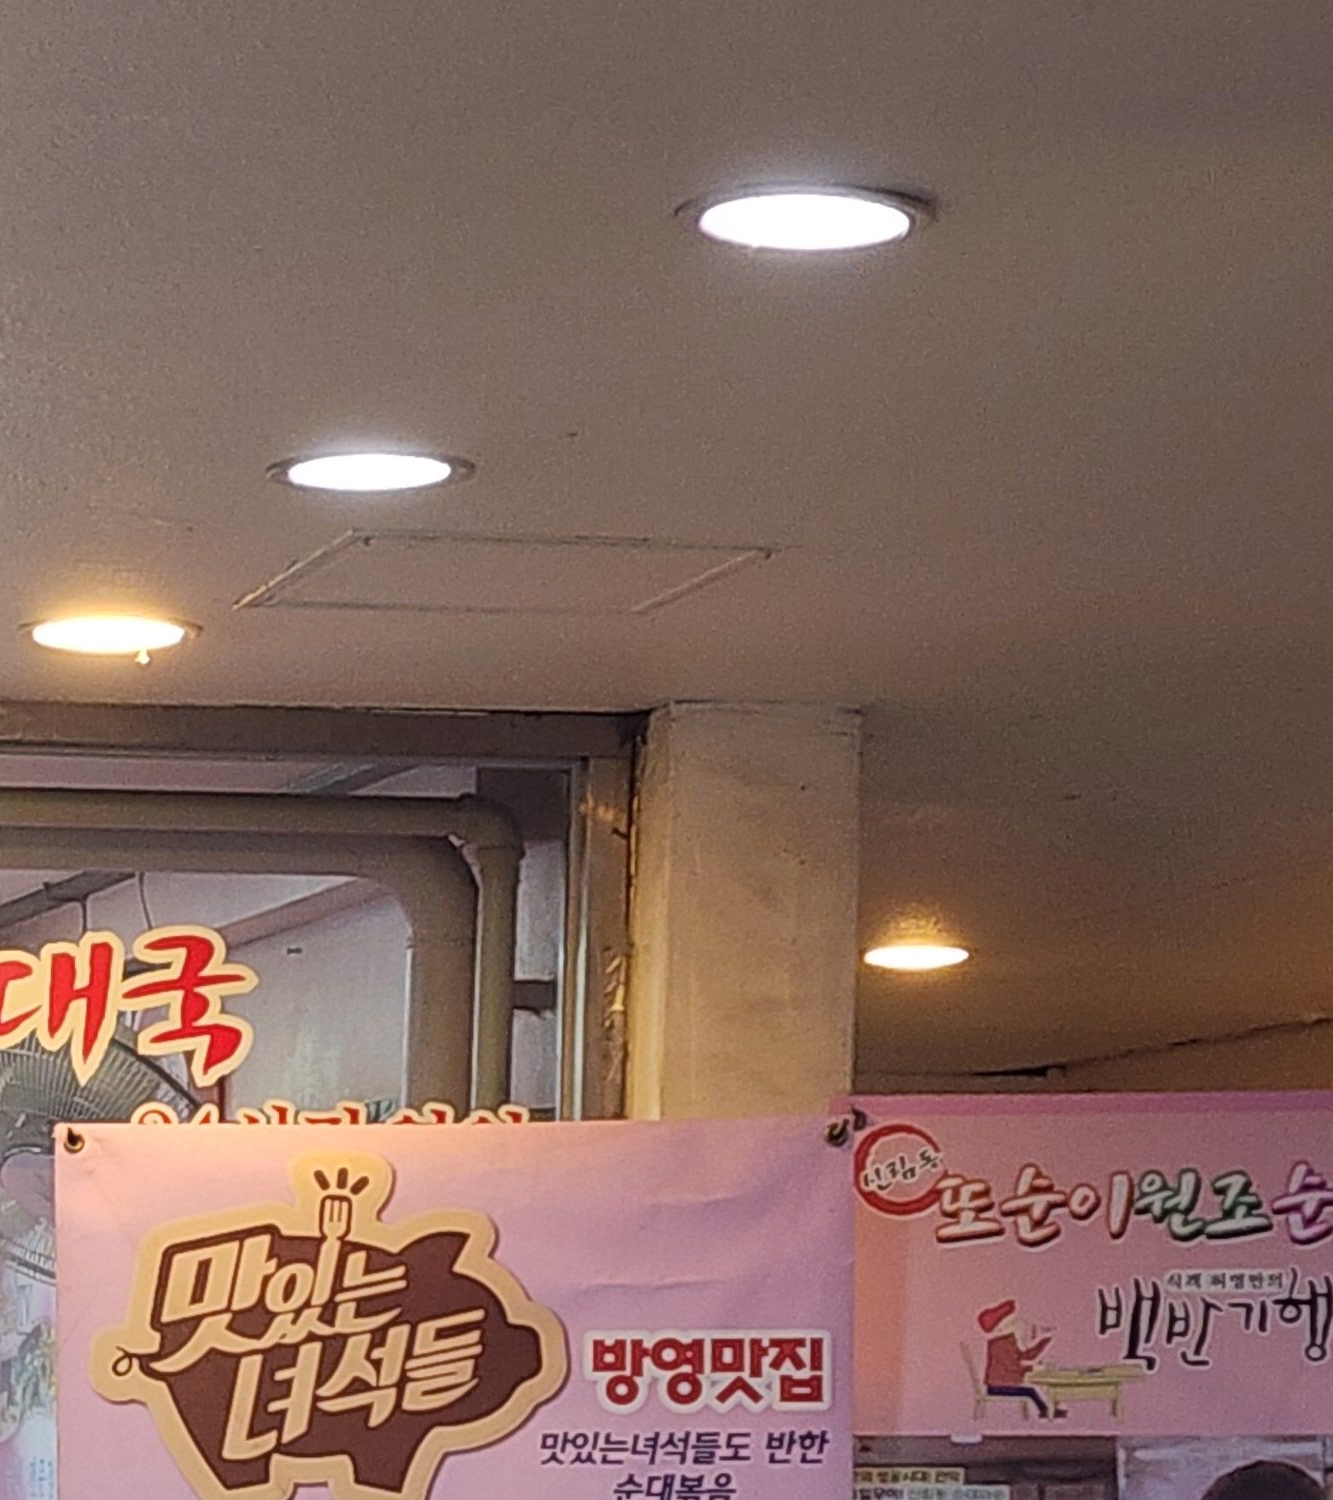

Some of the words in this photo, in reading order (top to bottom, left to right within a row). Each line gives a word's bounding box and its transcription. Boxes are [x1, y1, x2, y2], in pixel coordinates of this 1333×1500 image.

[153, 1232, 408, 1373] 맛있는
[221, 1306, 487, 1461] 녀석들
[591, 1335, 827, 1406] 방영맛집
[540, 1430, 752, 1465] 맛있는녀석들도
[766, 1430, 830, 1464] 반한
